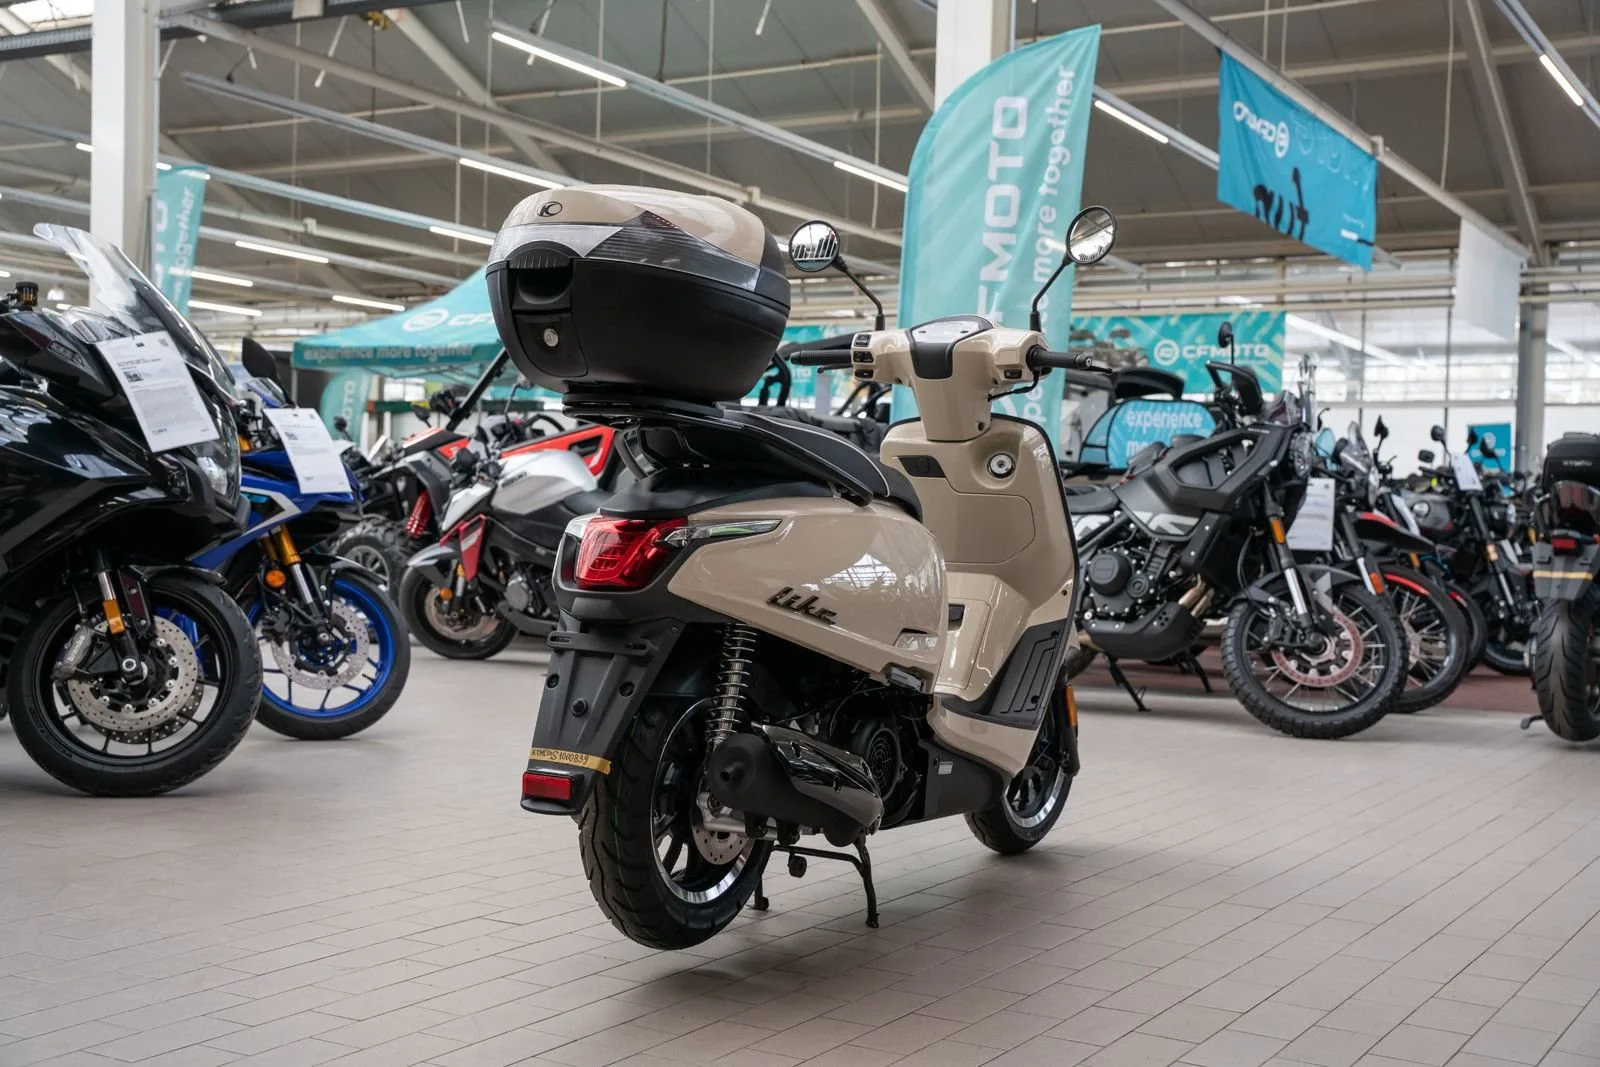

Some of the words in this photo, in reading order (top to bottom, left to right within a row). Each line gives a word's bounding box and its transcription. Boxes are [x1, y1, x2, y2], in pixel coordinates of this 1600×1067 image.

[1038, 64, 1076, 197] together
[976, 95, 1028, 323] FMOTO
[1032, 204, 1058, 284] more
[1127, 406, 1202, 435] experience
